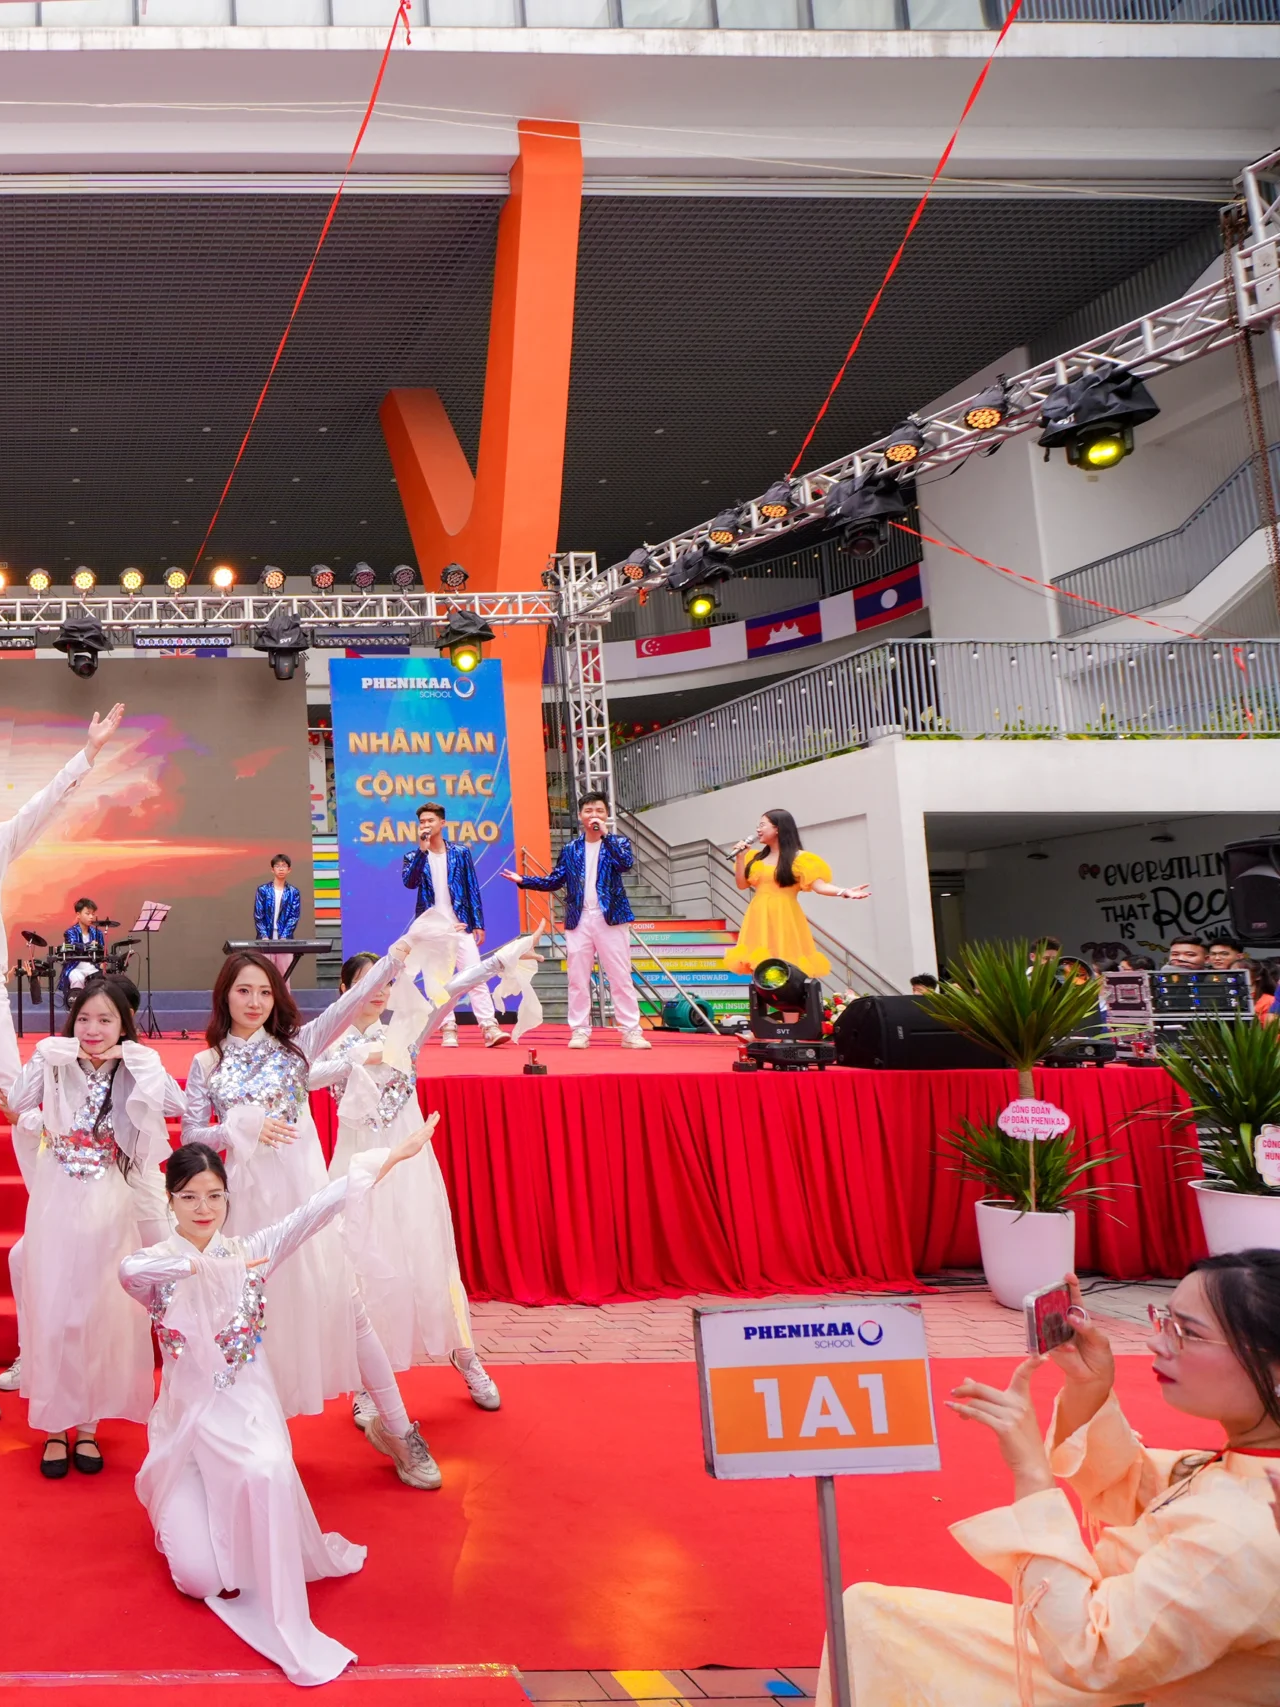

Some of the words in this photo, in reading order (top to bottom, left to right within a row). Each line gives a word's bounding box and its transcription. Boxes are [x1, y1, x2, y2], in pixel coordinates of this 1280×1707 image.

[361, 677, 452, 690] PHENIKAA
[348, 728, 431, 753] NHÂN
[435, 727, 495, 753] VĂN
[355, 771, 436, 802] CỘNG
[440, 769, 494, 796] TÁC
[359, 816, 423, 844] SÁN
[444, 820, 500, 847] TẠO
[1101, 903, 1152, 922] THAT
[1120, 922, 1136, 939] IS
[725, 1002, 750, 1010] INSIDE
[1011, 1105, 1030, 1114] CÔNG
[1031, 1116, 1066, 1126] PHENIKAA
[743, 1321, 855, 1341] PHENIKAA
[814, 1338, 856, 1350] SCHOOL
[753, 1372, 890, 1440] 1A1
